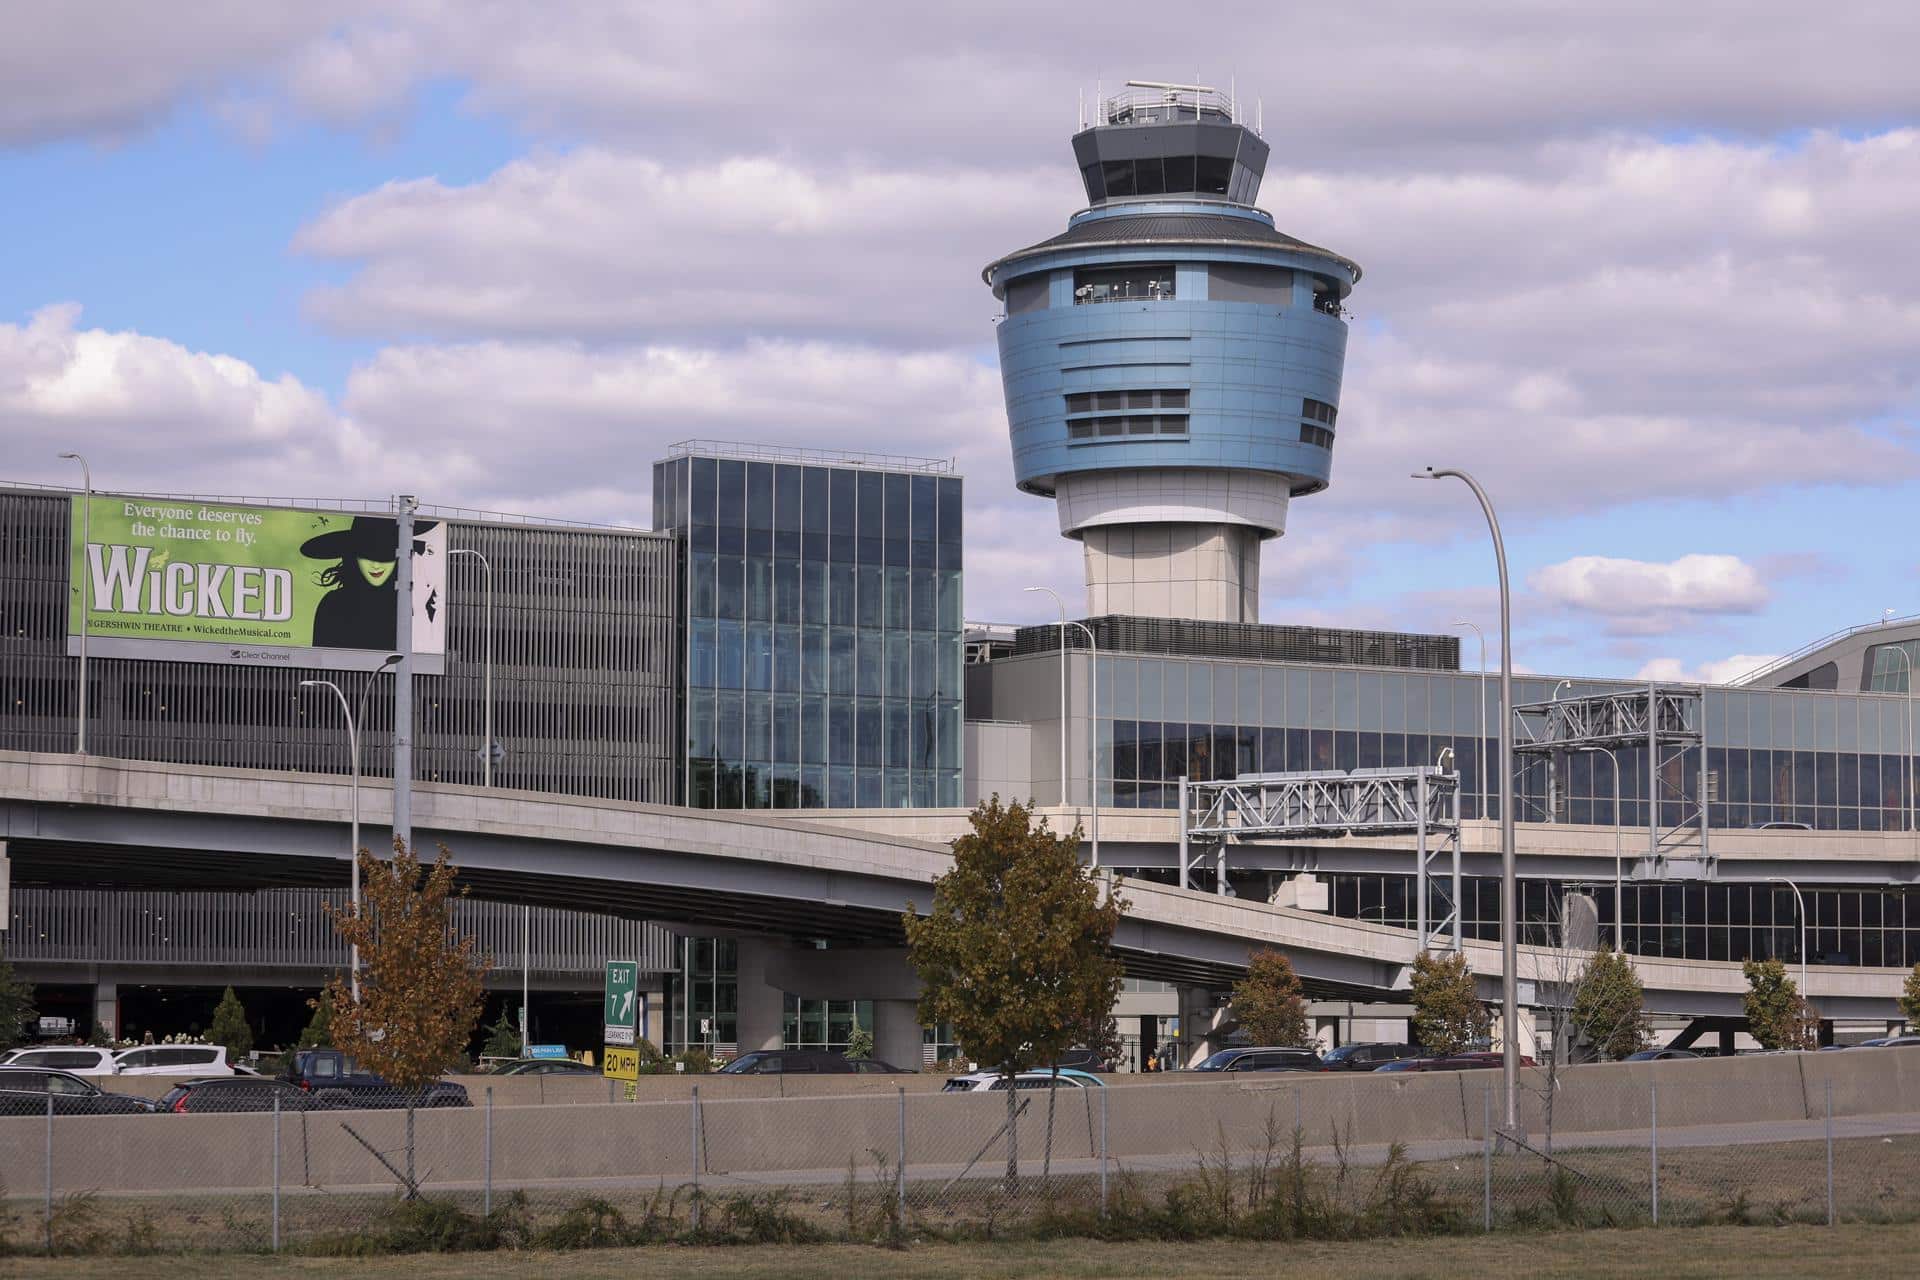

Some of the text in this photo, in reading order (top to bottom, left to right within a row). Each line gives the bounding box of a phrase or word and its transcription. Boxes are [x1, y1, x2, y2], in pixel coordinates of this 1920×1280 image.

[123, 502, 263, 525] Everyone deserves
[131, 521, 257, 546] the chance to fly.
[94, 619, 141, 630] GERSHWIN
[143, 622, 183, 633] THEATRE
[193, 624, 291, 638] WickedtheMusical.com
[241, 650, 290, 661] Clear Channel
[612, 968, 630, 984] EXIT
[611, 994, 617, 1016] 7
[606, 1054, 636, 1073] 20 MPH
